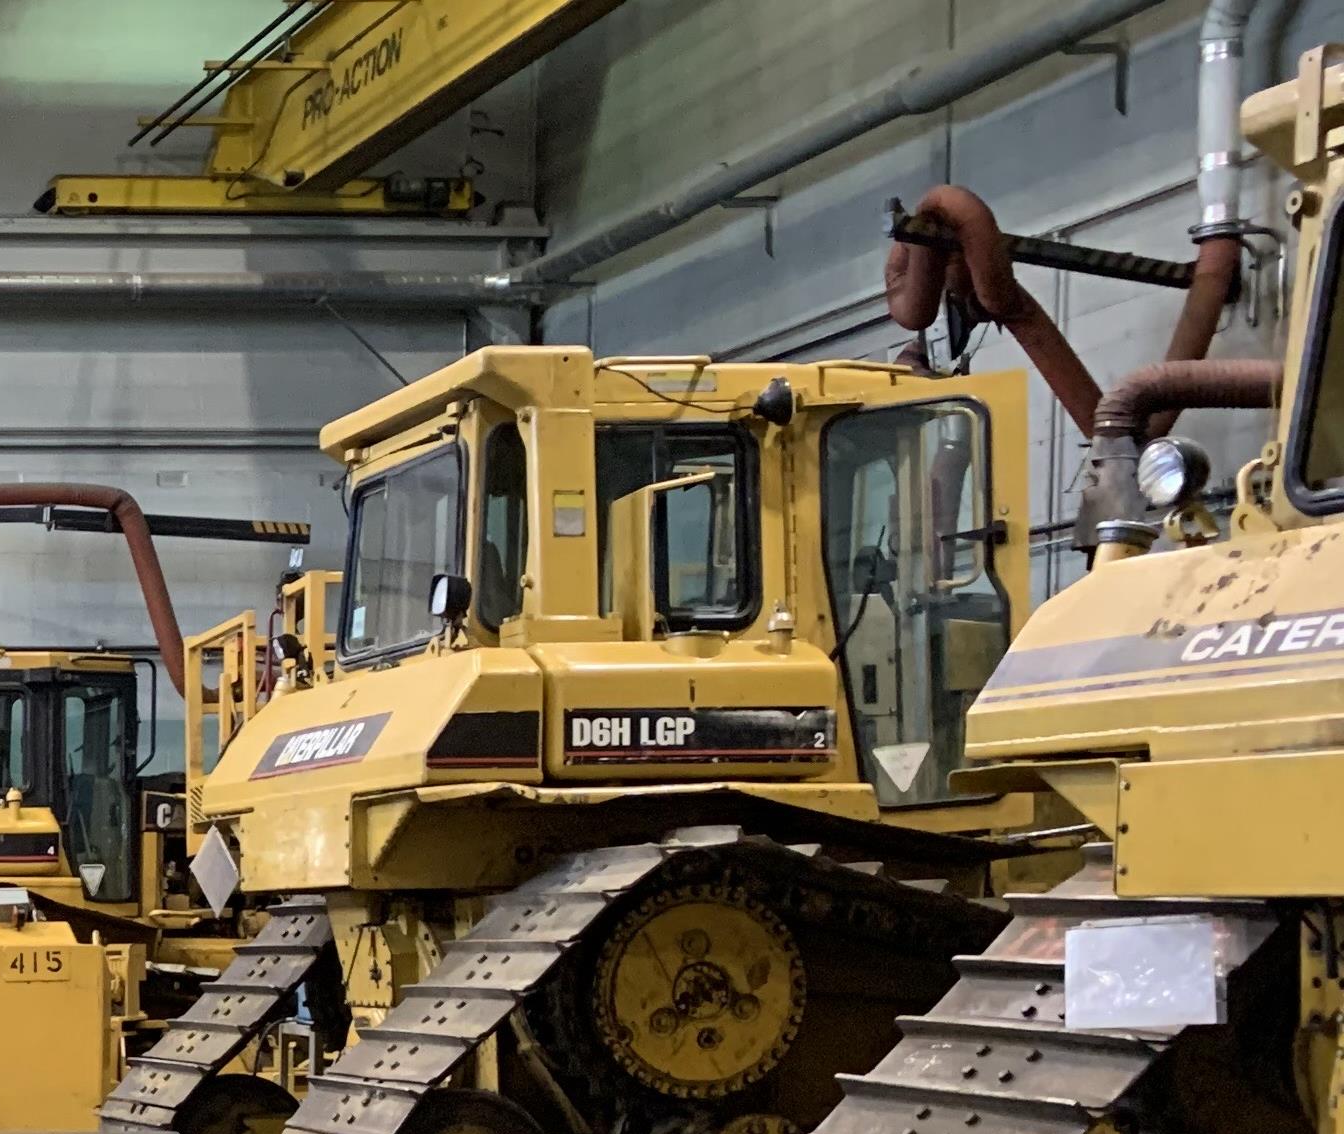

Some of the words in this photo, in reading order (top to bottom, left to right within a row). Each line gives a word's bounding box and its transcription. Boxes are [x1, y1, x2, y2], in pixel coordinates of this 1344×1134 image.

[302, 27, 403, 130] PRO-ACTION
[571, 717, 631, 746] D6H
[640, 717, 696, 746] LGP
[814, 732, 826, 748] 2
[47, 846, 55, 855] 4
[10, 951, 62, 974] 415
